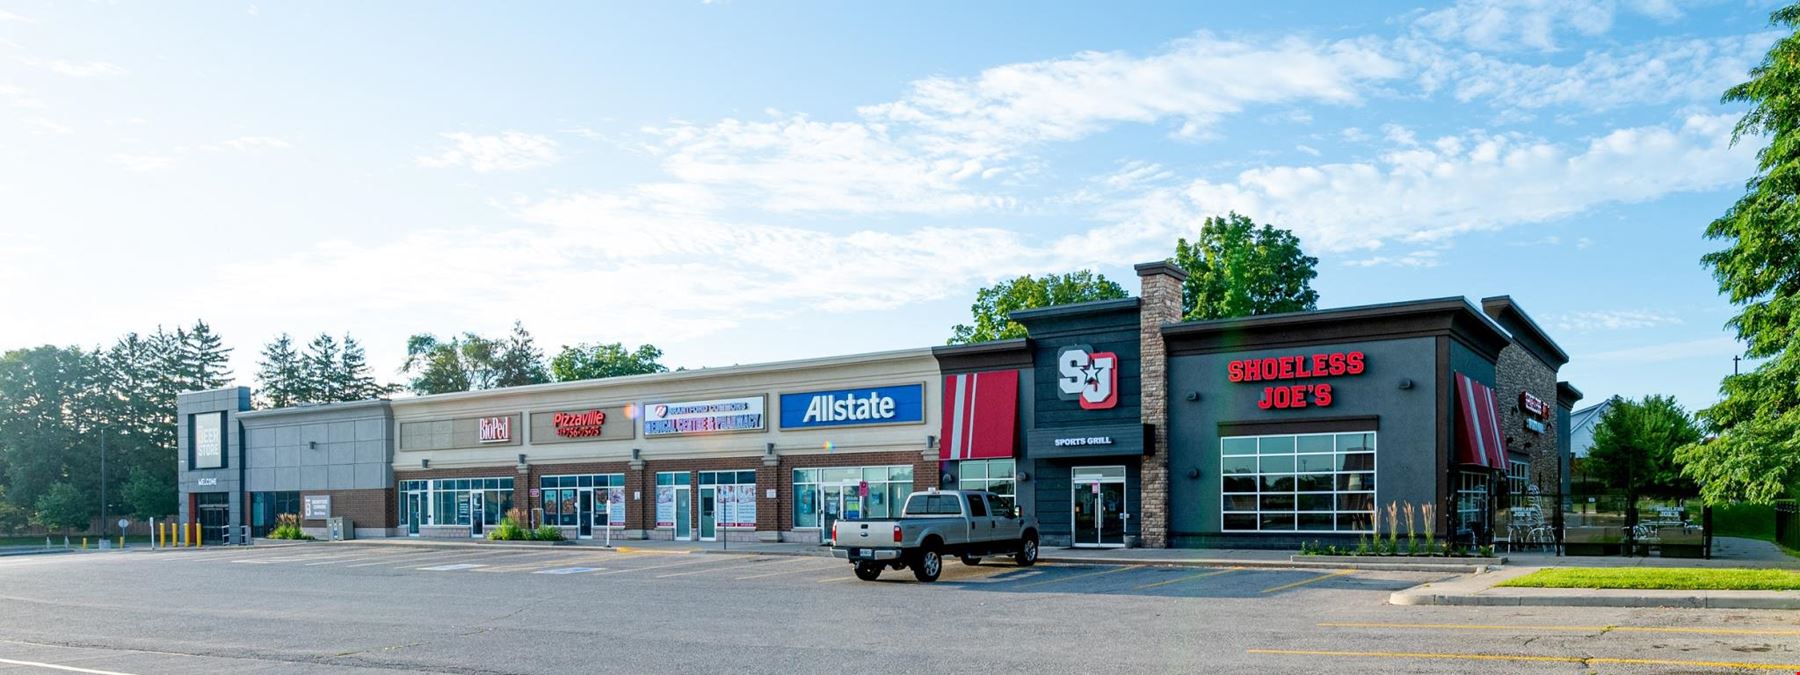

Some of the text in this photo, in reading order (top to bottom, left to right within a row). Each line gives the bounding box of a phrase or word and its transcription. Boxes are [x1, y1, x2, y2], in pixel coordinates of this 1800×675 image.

[1228, 351, 1365, 383] SHOELESS
[802, 391, 896, 423] Allstate
[1257, 383, 1333, 410] JOE'S
[479, 416, 509, 441] BioPed
[553, 410, 604, 427] Pizzaville
[198, 443, 219, 457] STORE
[1054, 436, 1112, 447] SPORTS GRILL
[198, 477, 217, 486] WELCOME
